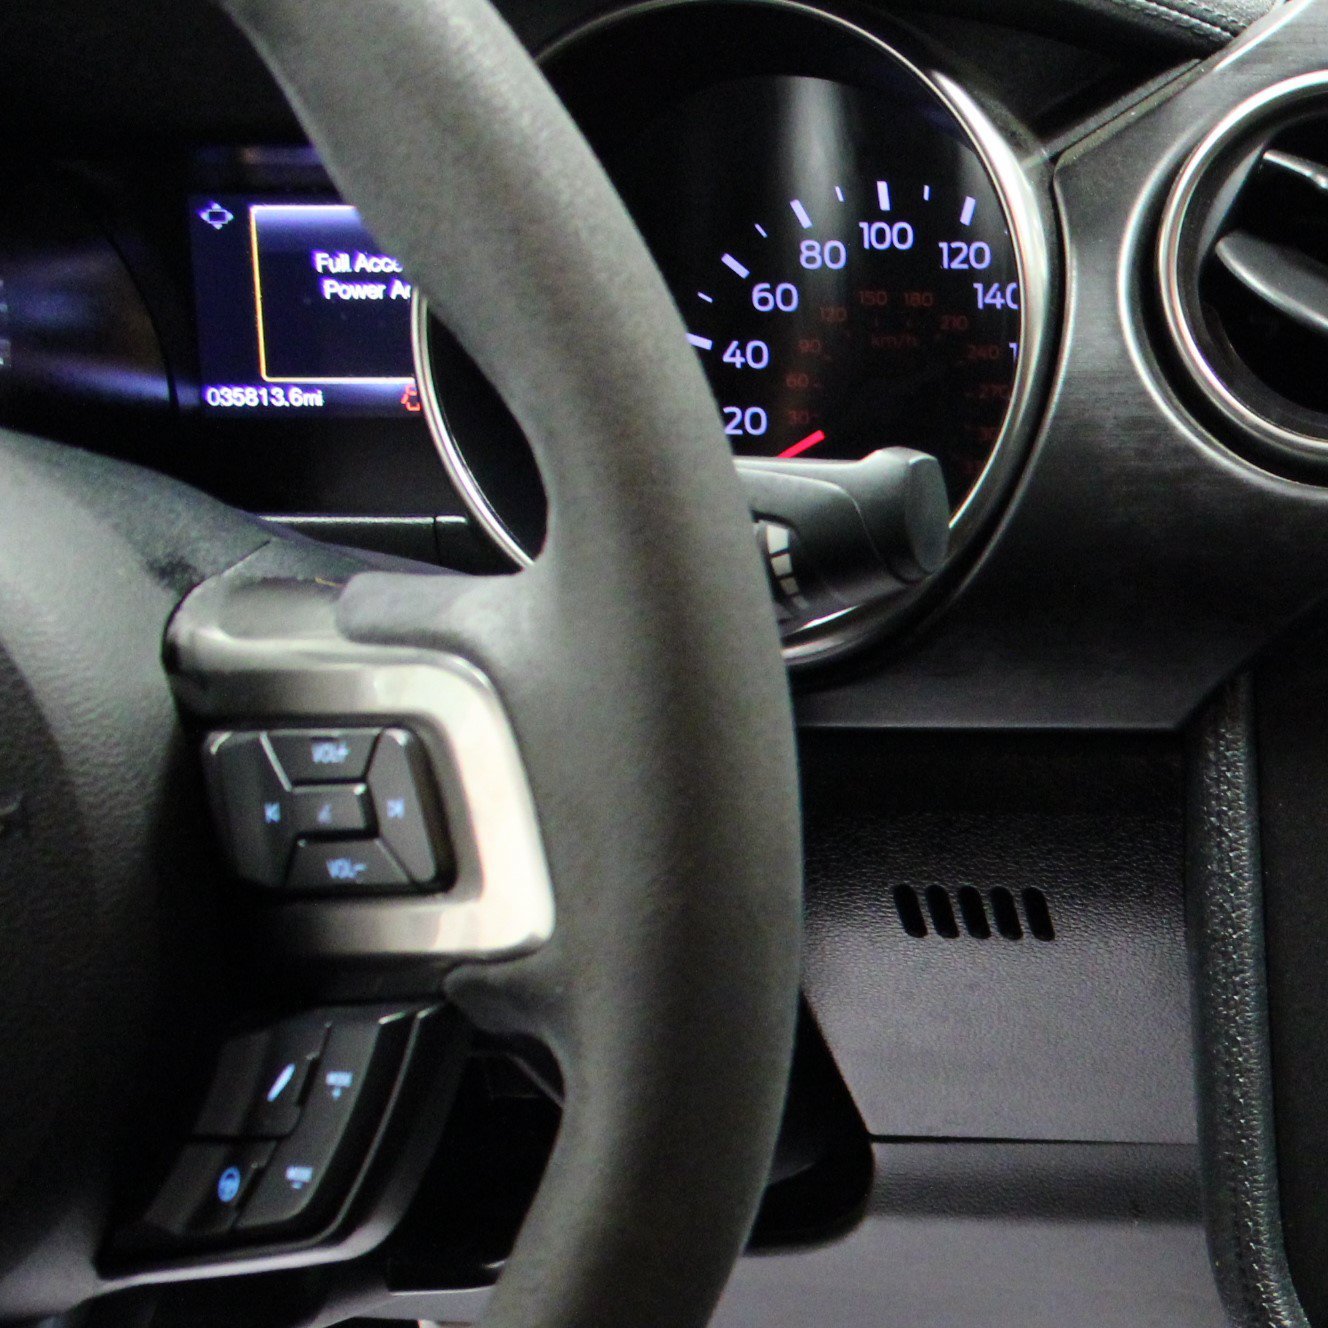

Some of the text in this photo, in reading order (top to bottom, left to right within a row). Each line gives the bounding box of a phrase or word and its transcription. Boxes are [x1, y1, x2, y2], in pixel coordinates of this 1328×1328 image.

[860, 222, 914, 250] 100
[313, 251, 352, 273] Full
[800, 240, 846, 269] 80
[939, 242, 991, 269] 120
[322, 278, 386, 300] Power
[751, 283, 799, 312] 60
[722, 340, 769, 369] 40
[723, 406, 768, 435] 20
